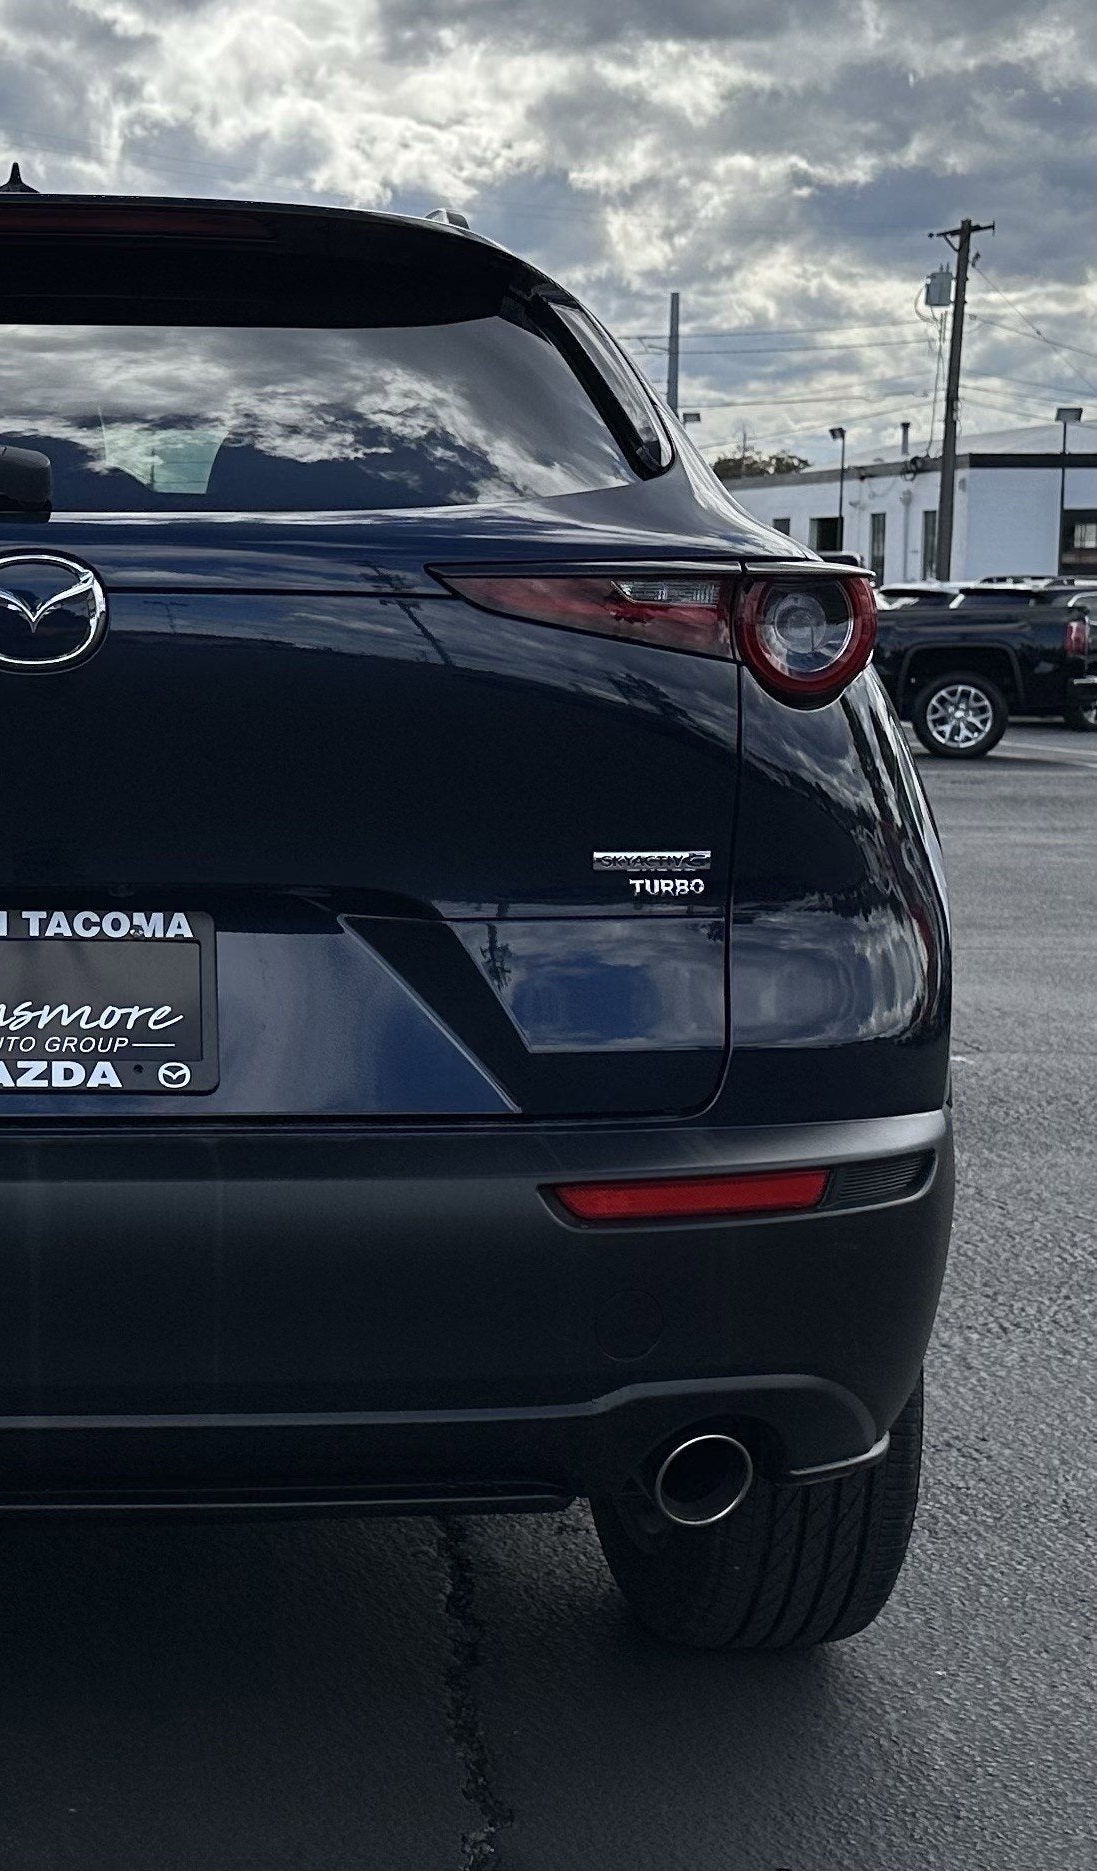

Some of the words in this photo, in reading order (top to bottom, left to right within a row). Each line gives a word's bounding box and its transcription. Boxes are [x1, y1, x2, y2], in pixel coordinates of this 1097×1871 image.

[629, 878, 705, 896] TURBO
[21, 911, 194, 938] TACOMA
[44, 1036, 129, 1053] GROUP
